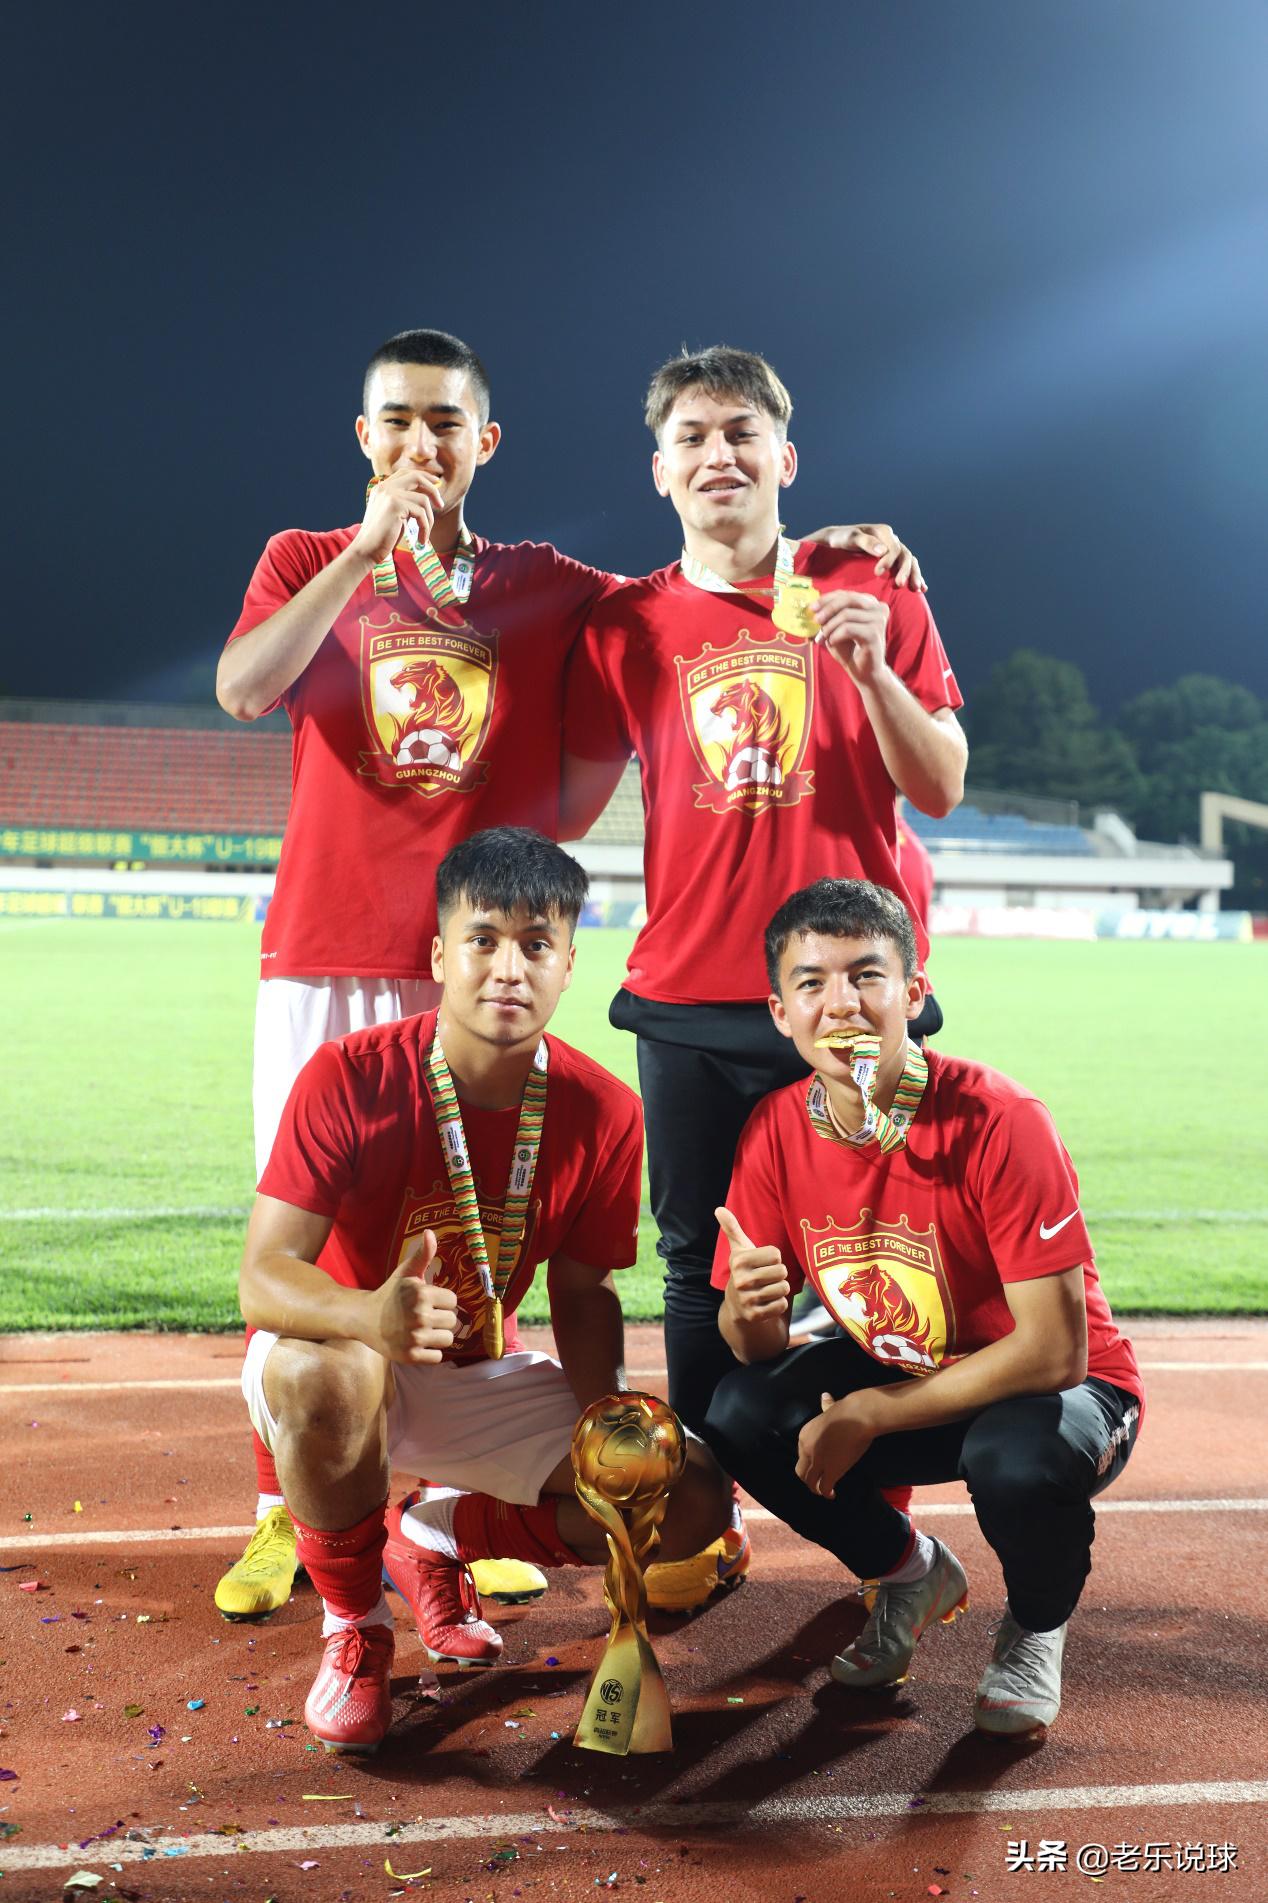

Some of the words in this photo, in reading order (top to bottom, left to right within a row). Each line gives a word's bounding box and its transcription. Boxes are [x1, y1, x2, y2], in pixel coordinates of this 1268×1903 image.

[377, 639, 392, 651] BE
[396, 637, 416, 647] THE
[418, 636, 443, 646] BEST
[445, 638, 487, 659] FOREVER
[693, 671, 708, 684] BE
[710, 661, 729, 676] THE
[731, 656, 755, 667] BEST
[756, 654, 799, 669] FOREVER
[396, 768, 460, 783] GUANGZHOU
[414, 1212, 430, 1225] BE
[433, 1207, 450, 1220] THE
[481, 1212, 504, 1223] FORE
[819, 1245, 835, 1258] BE
[837, 1243, 852, 1253] THE
[855, 1239, 881, 1252] BEST
[884, 1239, 926, 1261] FOREVER
[595, 1709, 622, 1725] 冠军
